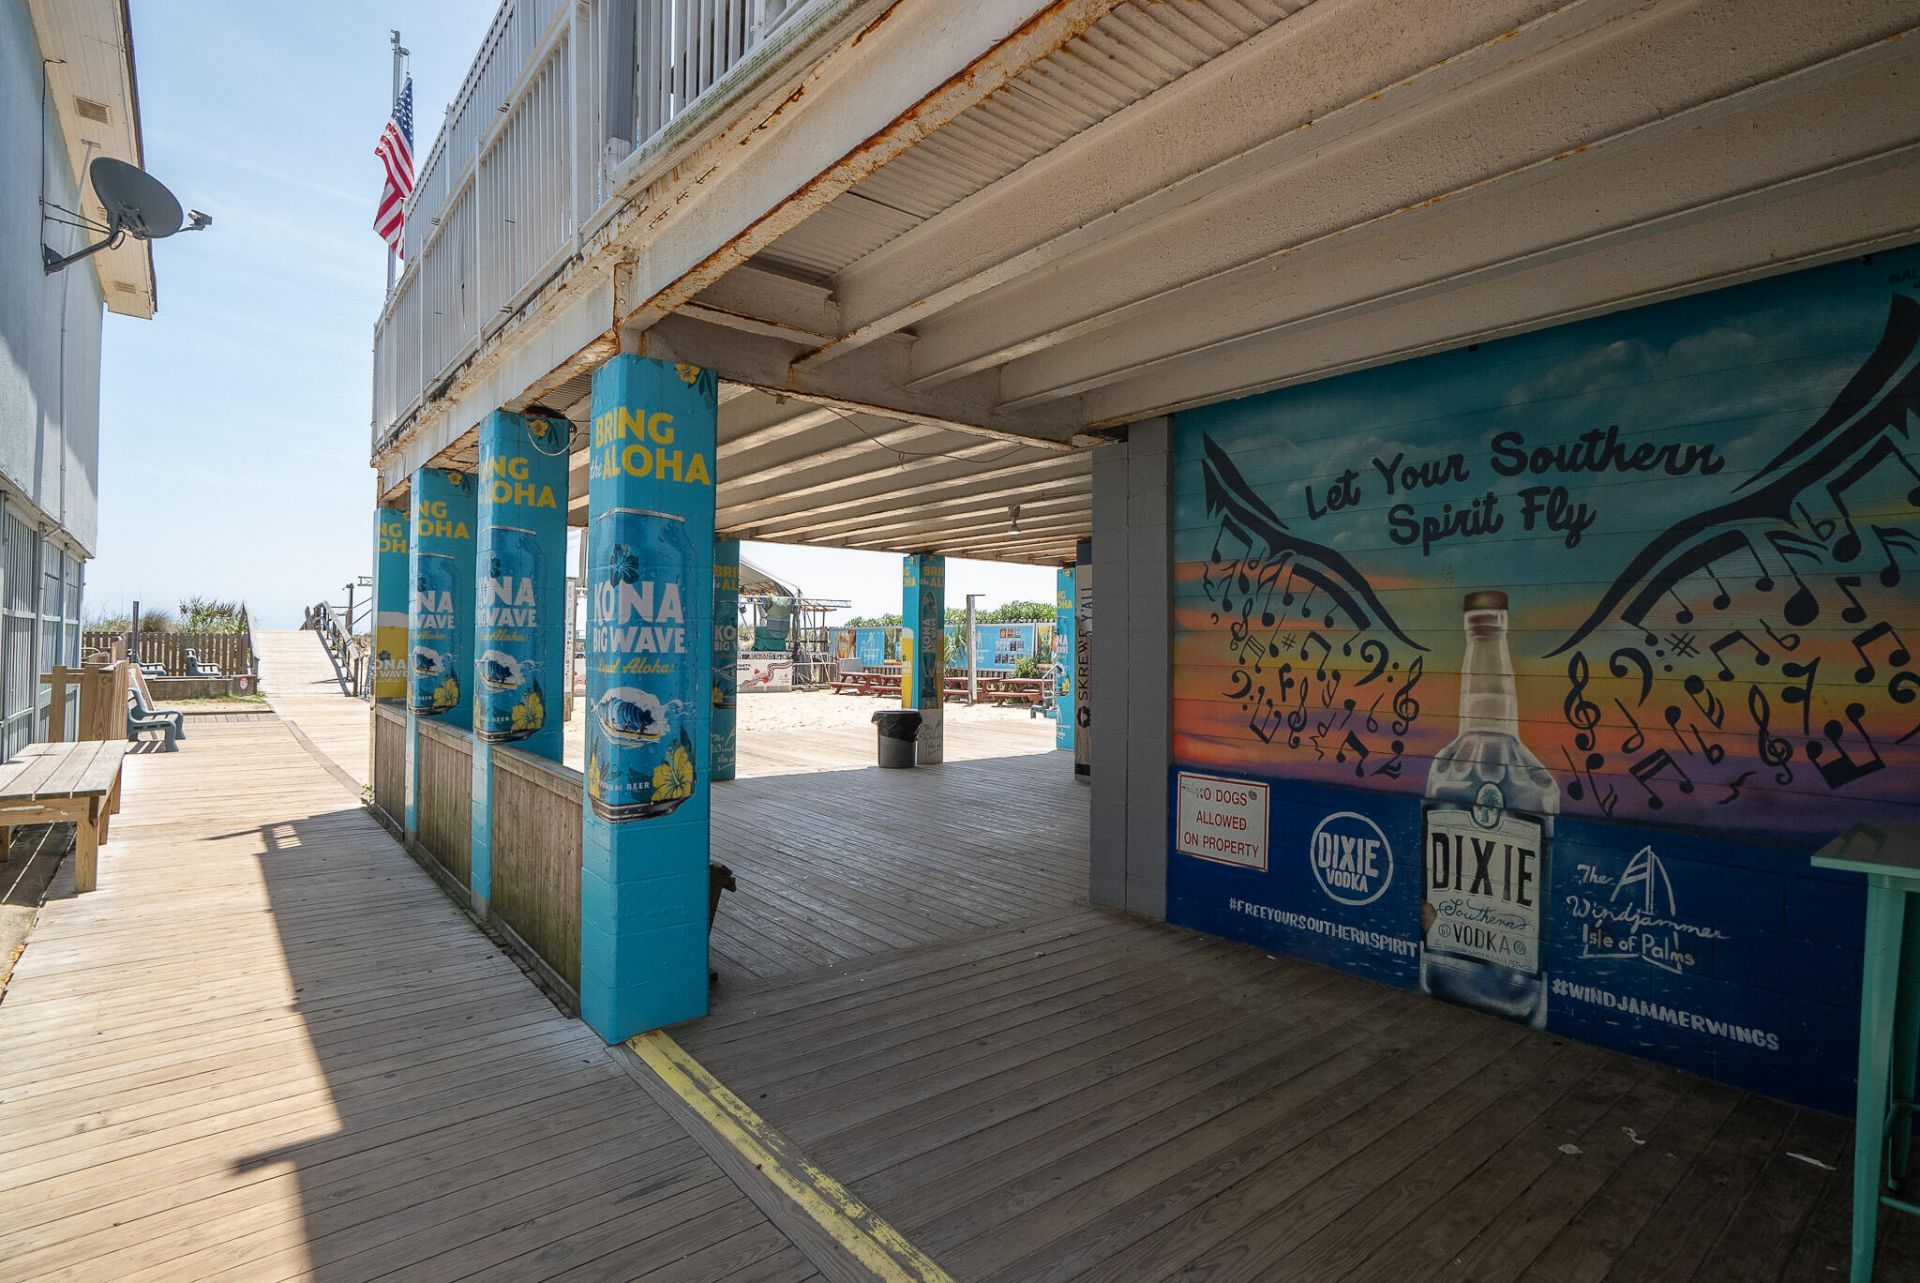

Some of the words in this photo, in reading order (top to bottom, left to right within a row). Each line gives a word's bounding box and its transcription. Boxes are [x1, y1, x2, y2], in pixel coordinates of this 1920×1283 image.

[595, 406, 675, 448] BRING
[602, 444, 711, 485] ALOHA
[1304, 468, 1361, 520] Let
[1372, 452, 1470, 495] Your
[1490, 425, 1725, 476] Southern
[492, 480, 557, 509] OHA
[418, 519, 470, 540] OHA
[1387, 491, 1503, 556] Spirit
[1517, 486, 1597, 549] Fly
[593, 579, 684, 626] KONA
[593, 627, 608, 653] BIG
[376, 658, 407, 670] ONA
[627, 782, 650, 791] BEER
[1216, 789, 1247, 806] DOGS
[1196, 810, 1247, 831] ALLOWED
[1184, 832, 1198, 846] ON
[1203, 835, 1259, 858] PROPERTY
[1318, 832, 1380, 878] DIXIE
[1326, 867, 1368, 893] VODKA
[1431, 832, 1536, 907] DIXIE
[1576, 863, 1616, 885] The
[1229, 897, 1418, 958] #FREEYOURSOUTHERNSPIRIT
[1437, 898, 1530, 931] Southern
[1566, 895, 1731, 934] Windjammer
[1453, 923, 1512, 957] VODKA
[1582, 923, 1614, 948] Isle
[1618, 935, 1637, 951] of
[1641, 933, 1696, 966] Palms
[1552, 976, 1780, 1052] #WINDJAMMERWINGS
